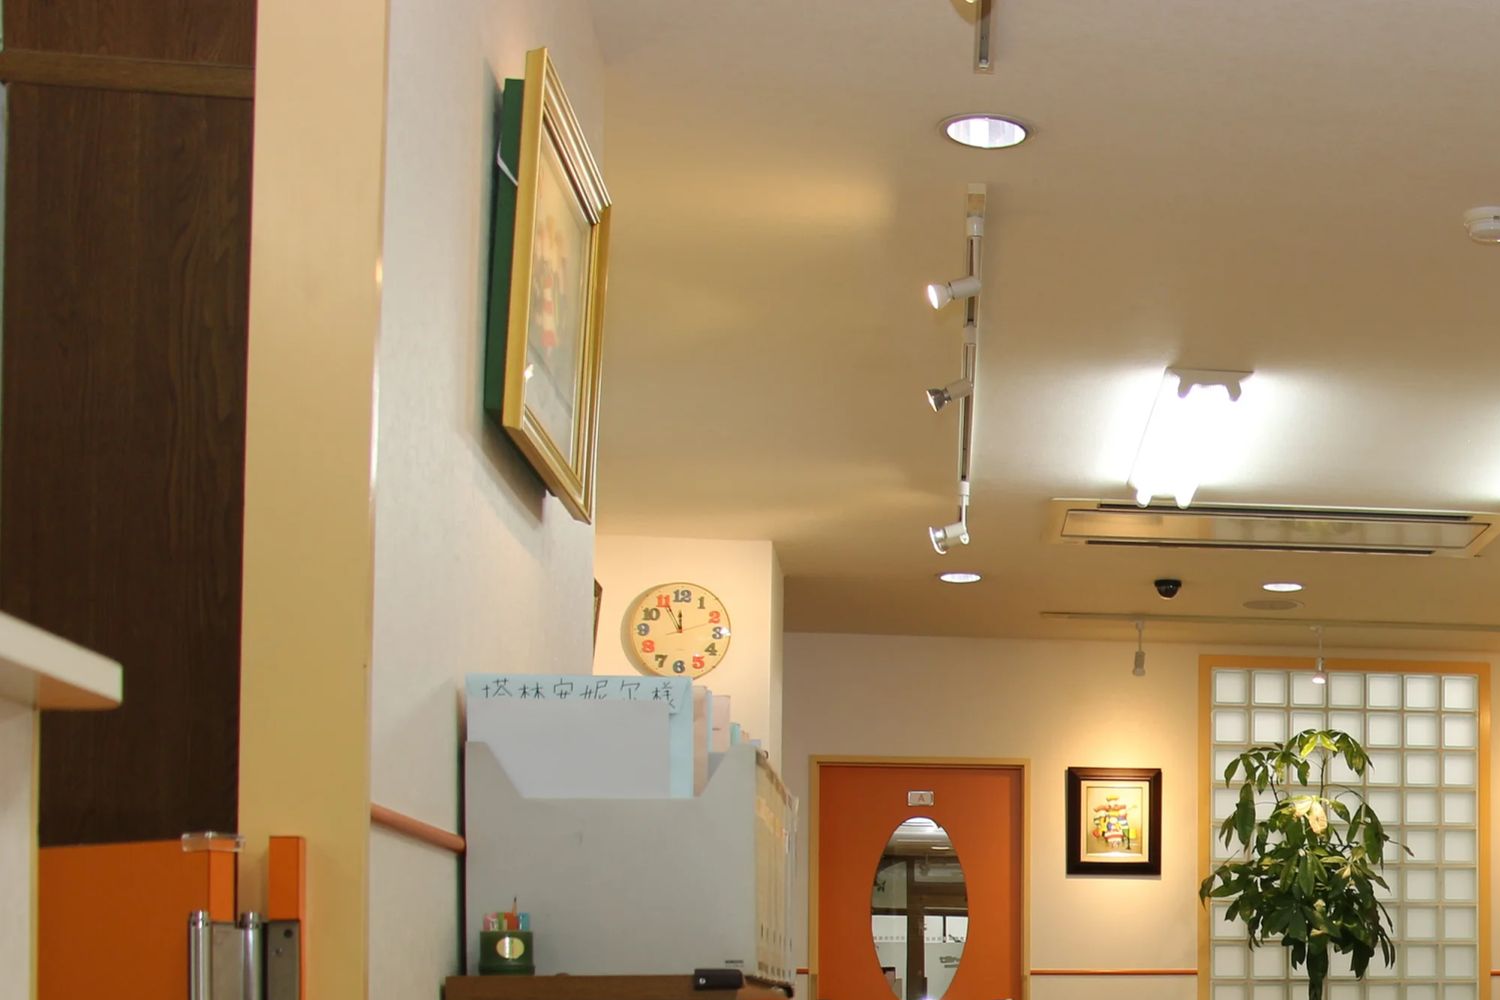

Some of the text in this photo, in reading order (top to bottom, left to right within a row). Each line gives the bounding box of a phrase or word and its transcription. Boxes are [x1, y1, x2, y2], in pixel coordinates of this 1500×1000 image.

[656, 594, 671, 608] 11
[673, 589, 692, 603] 12
[697, 596, 706, 609] 1
[642, 608, 660, 621] 10
[708, 611, 720, 624] 2
[637, 623, 649, 636] 9
[712, 626, 723, 639] 3
[642, 640, 655, 653] 8
[704, 642, 718, 656] 4
[655, 654, 667, 668] 7
[673, 660, 685, 674] 6
[692, 656, 704, 669] 5
